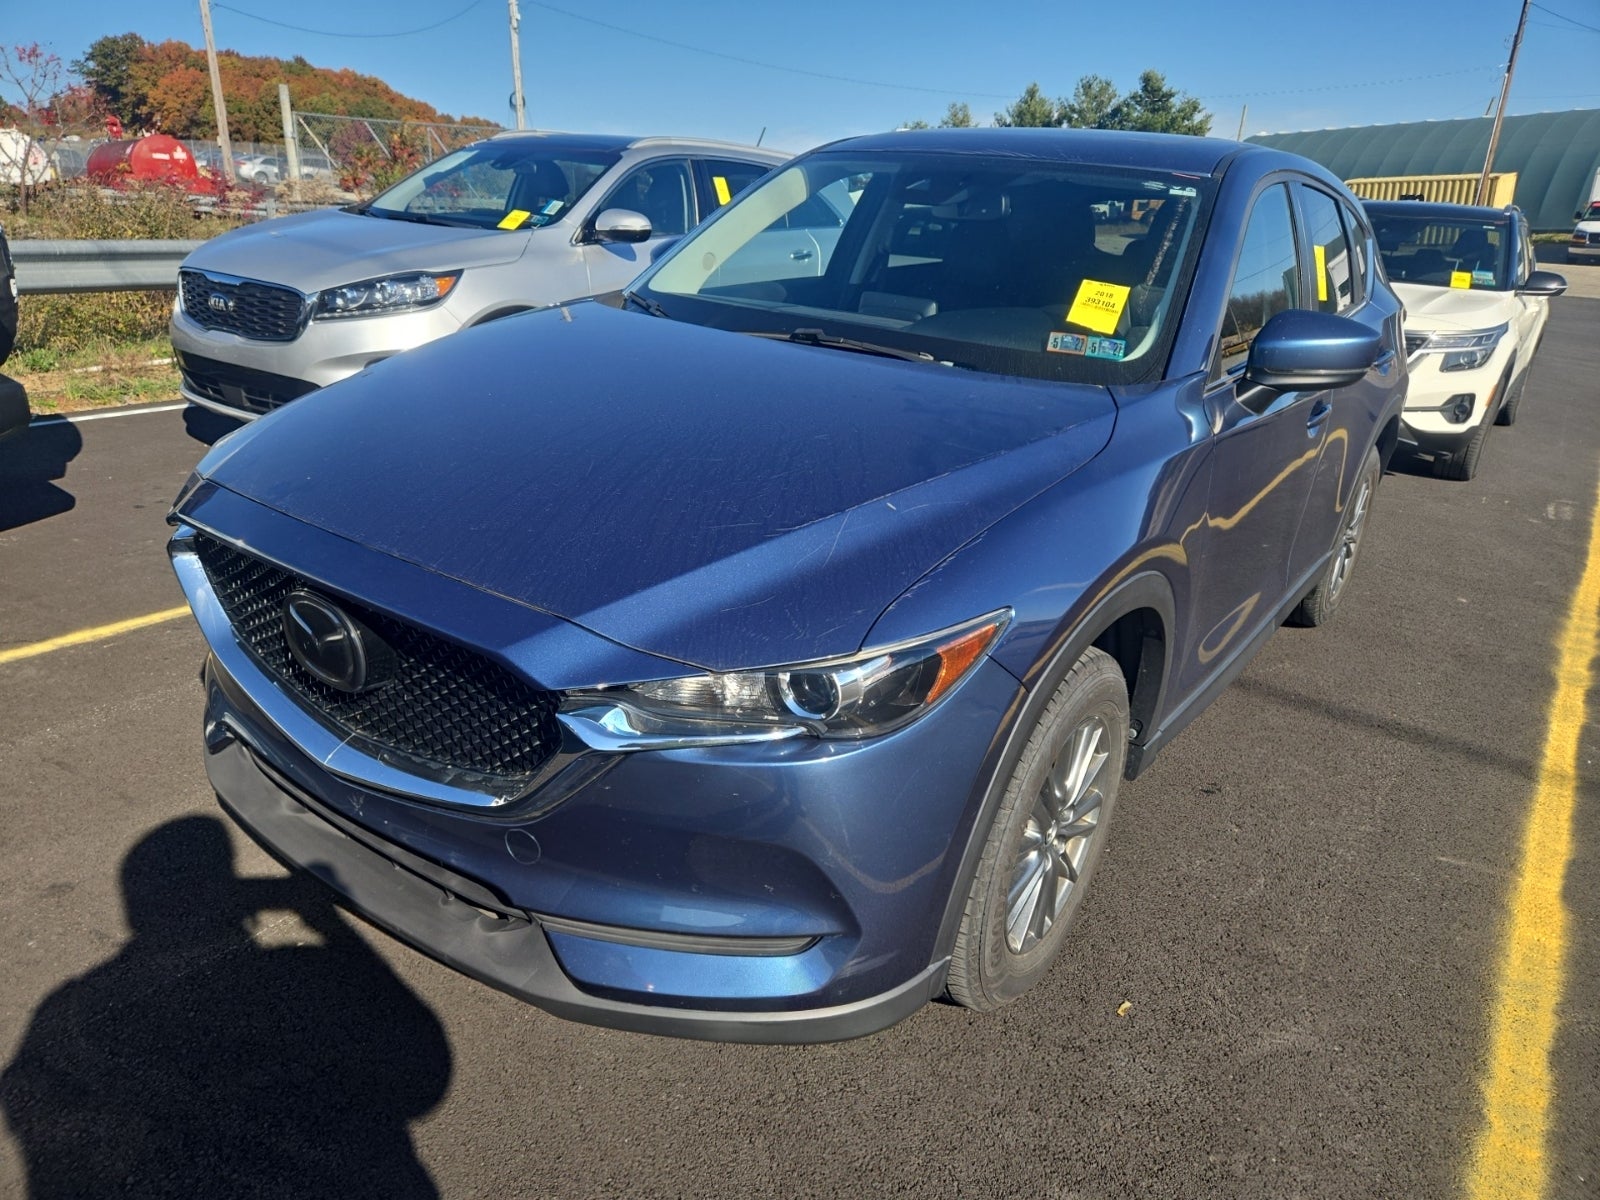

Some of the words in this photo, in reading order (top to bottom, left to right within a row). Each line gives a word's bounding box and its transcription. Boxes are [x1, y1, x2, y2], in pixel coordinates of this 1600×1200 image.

[1095, 290, 1114, 298] 2018
[210, 296, 227, 311] KIA
[1085, 297, 1116, 309] 393104
